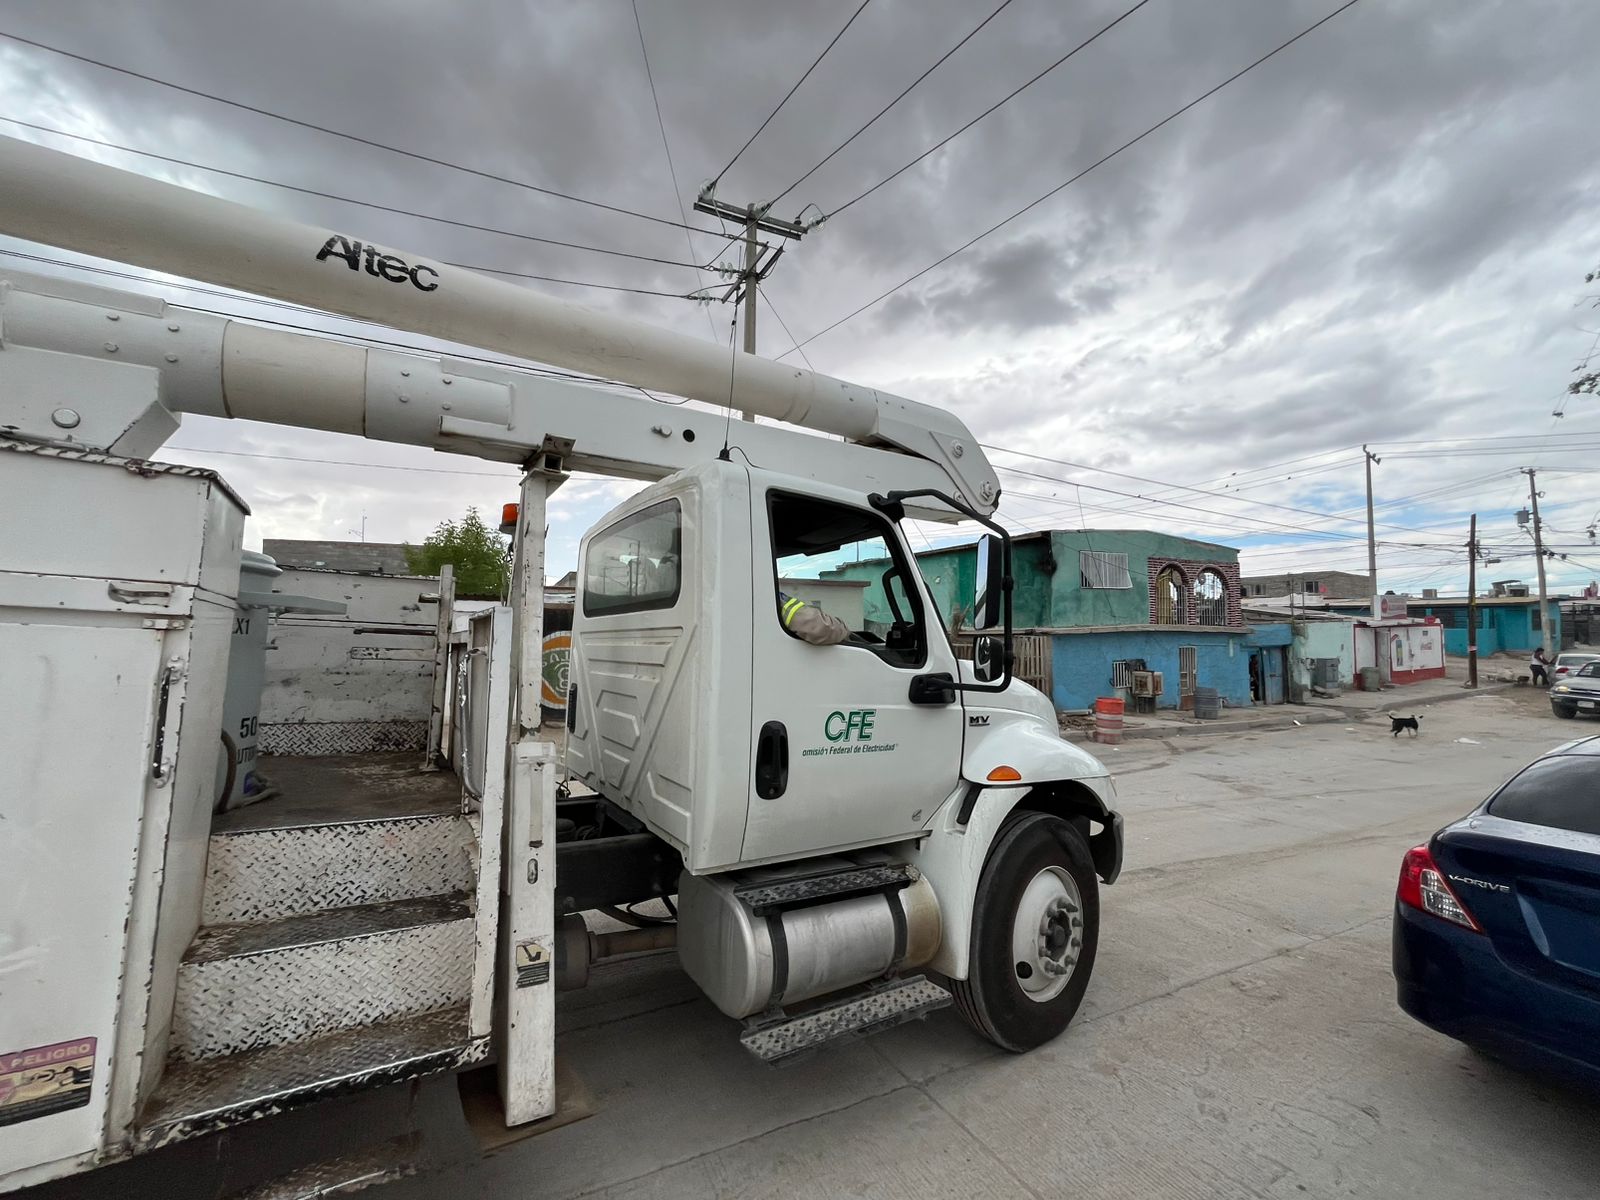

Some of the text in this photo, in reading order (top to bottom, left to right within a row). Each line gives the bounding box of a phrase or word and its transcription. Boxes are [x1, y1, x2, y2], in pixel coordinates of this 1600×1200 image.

[315, 234, 439, 292] Altec
[232, 617, 250, 635] X1
[240, 716, 258, 739] 50
[824, 708, 877, 743] CFE
[969, 715, 990, 726] MV
[829, 745, 853, 755] Federal
[854, 744, 861, 754] de
[862, 743, 896, 753] Electricidad
[11, 1043, 91, 1068] PELIGRO
